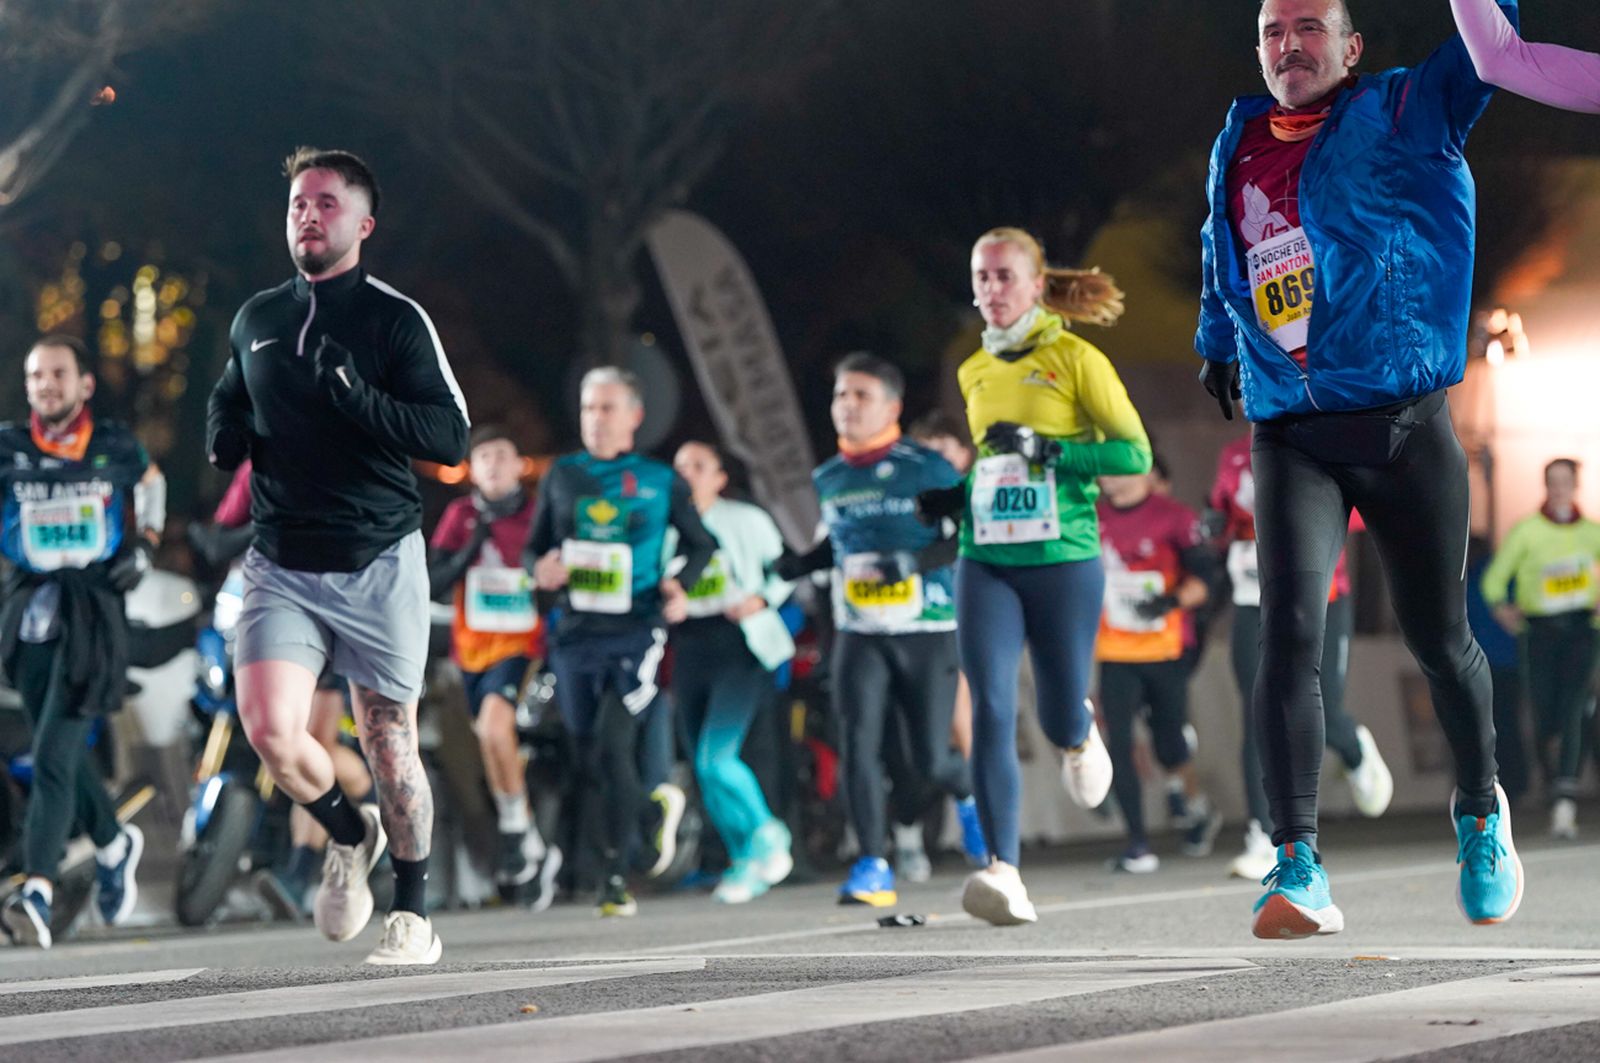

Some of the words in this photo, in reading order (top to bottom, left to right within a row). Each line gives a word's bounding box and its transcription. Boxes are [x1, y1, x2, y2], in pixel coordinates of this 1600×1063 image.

[1260, 247, 1292, 266] NOCHE
[1294, 240, 1307, 253] DE
[1256, 267, 1273, 285] SAN
[1275, 253, 1310, 277] ANTÓN
[1286, 310, 1302, 322] Juan
[13, 481, 49, 501] SAN
[992, 487, 1036, 512] 020
